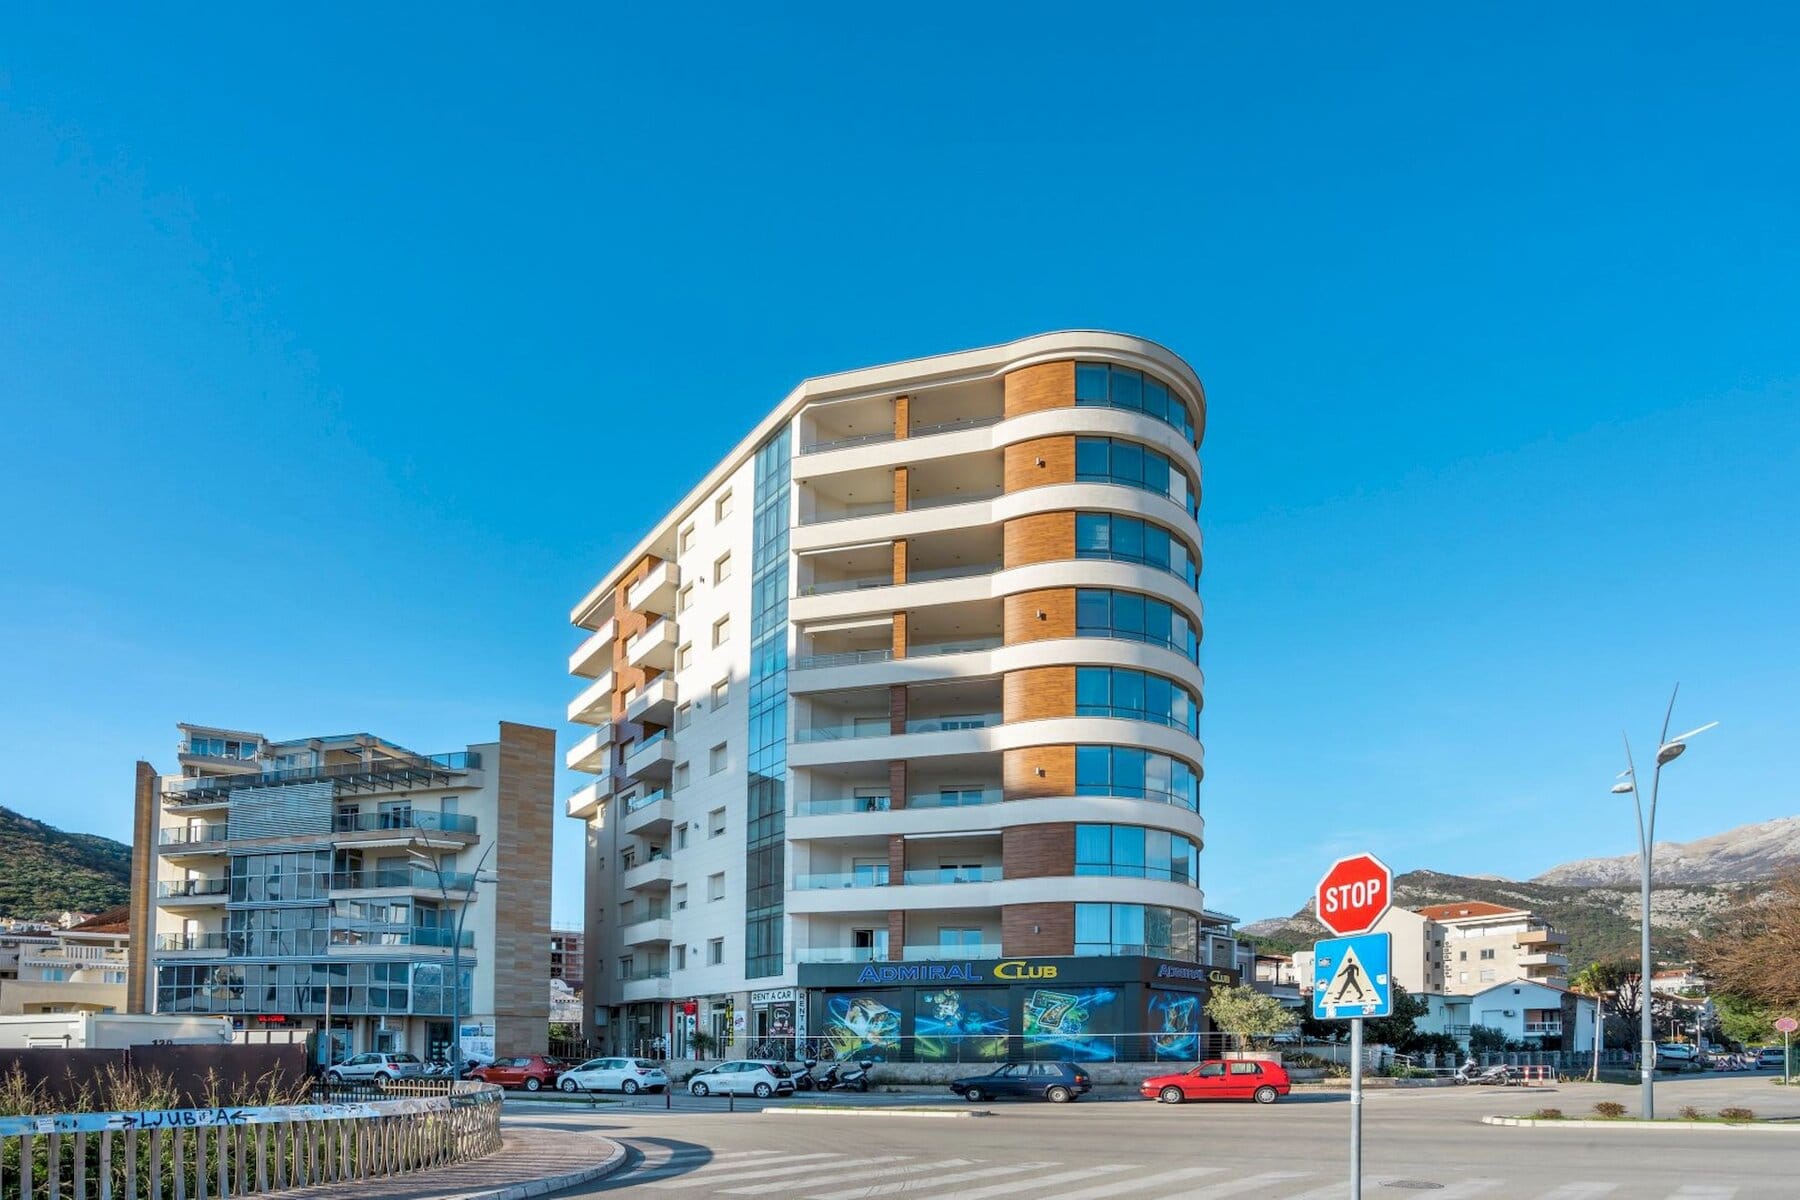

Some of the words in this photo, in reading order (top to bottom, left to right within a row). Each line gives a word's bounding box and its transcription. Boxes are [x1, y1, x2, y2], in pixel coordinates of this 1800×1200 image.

[1325, 878, 1381, 913] STOP
[857, 962, 983, 983] ADMIRAL
[993, 961, 1058, 980] CLUB
[752, 992, 770, 1001] RENT
[771, 992, 776, 1000] A
[777, 990, 792, 1000] CAR
